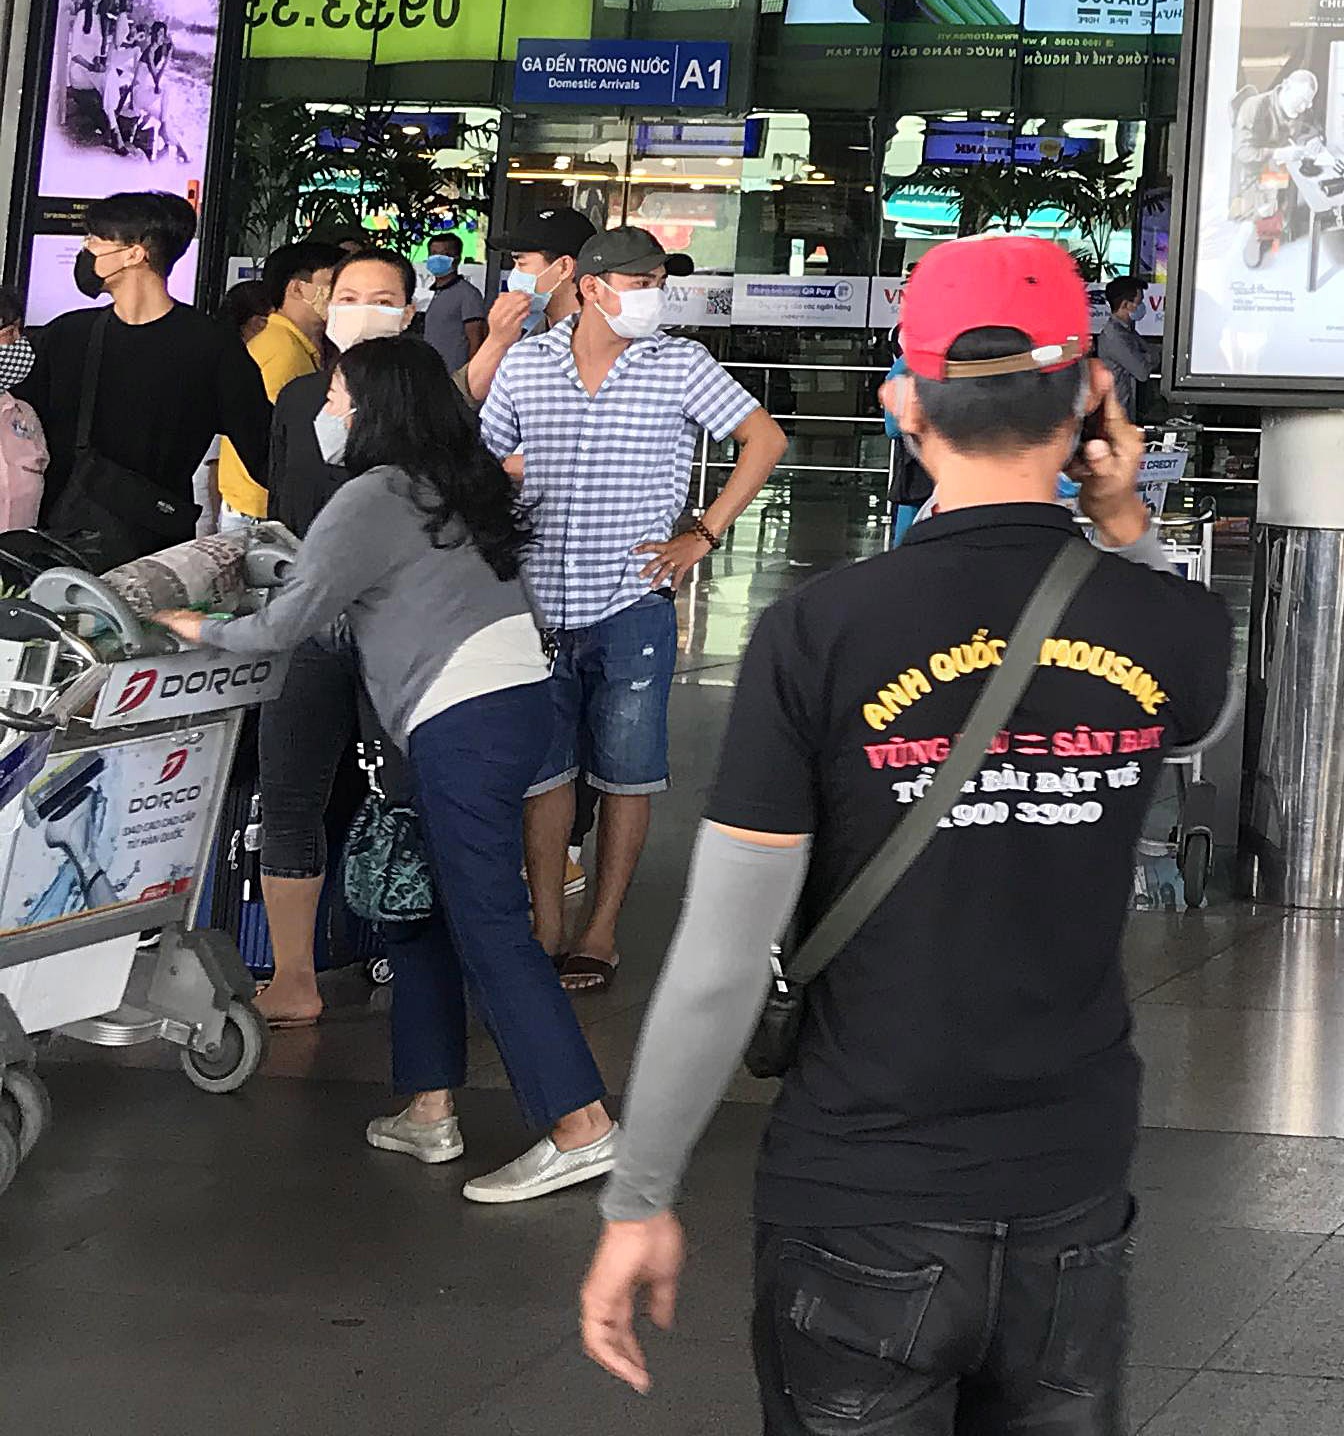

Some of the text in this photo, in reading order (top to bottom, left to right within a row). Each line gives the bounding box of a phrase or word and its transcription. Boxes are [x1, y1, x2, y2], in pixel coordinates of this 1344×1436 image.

[521, 57, 542, 72] GA
[546, 53, 575, 73] ĐẾN
[579, 58, 627, 73] TRONG
[679, 59, 722, 90] A1
[548, 78, 641, 90] Domestic Arrivals
[1147, 458, 1179, 470] CREDIT
[160, 660, 272, 699] DORCO
[863, 668, 932, 731] ANH
[1039, 638, 1170, 716] MOUSINE
[1052, 725, 1115, 756] SÂN
[128, 786, 201, 814] DORCO
